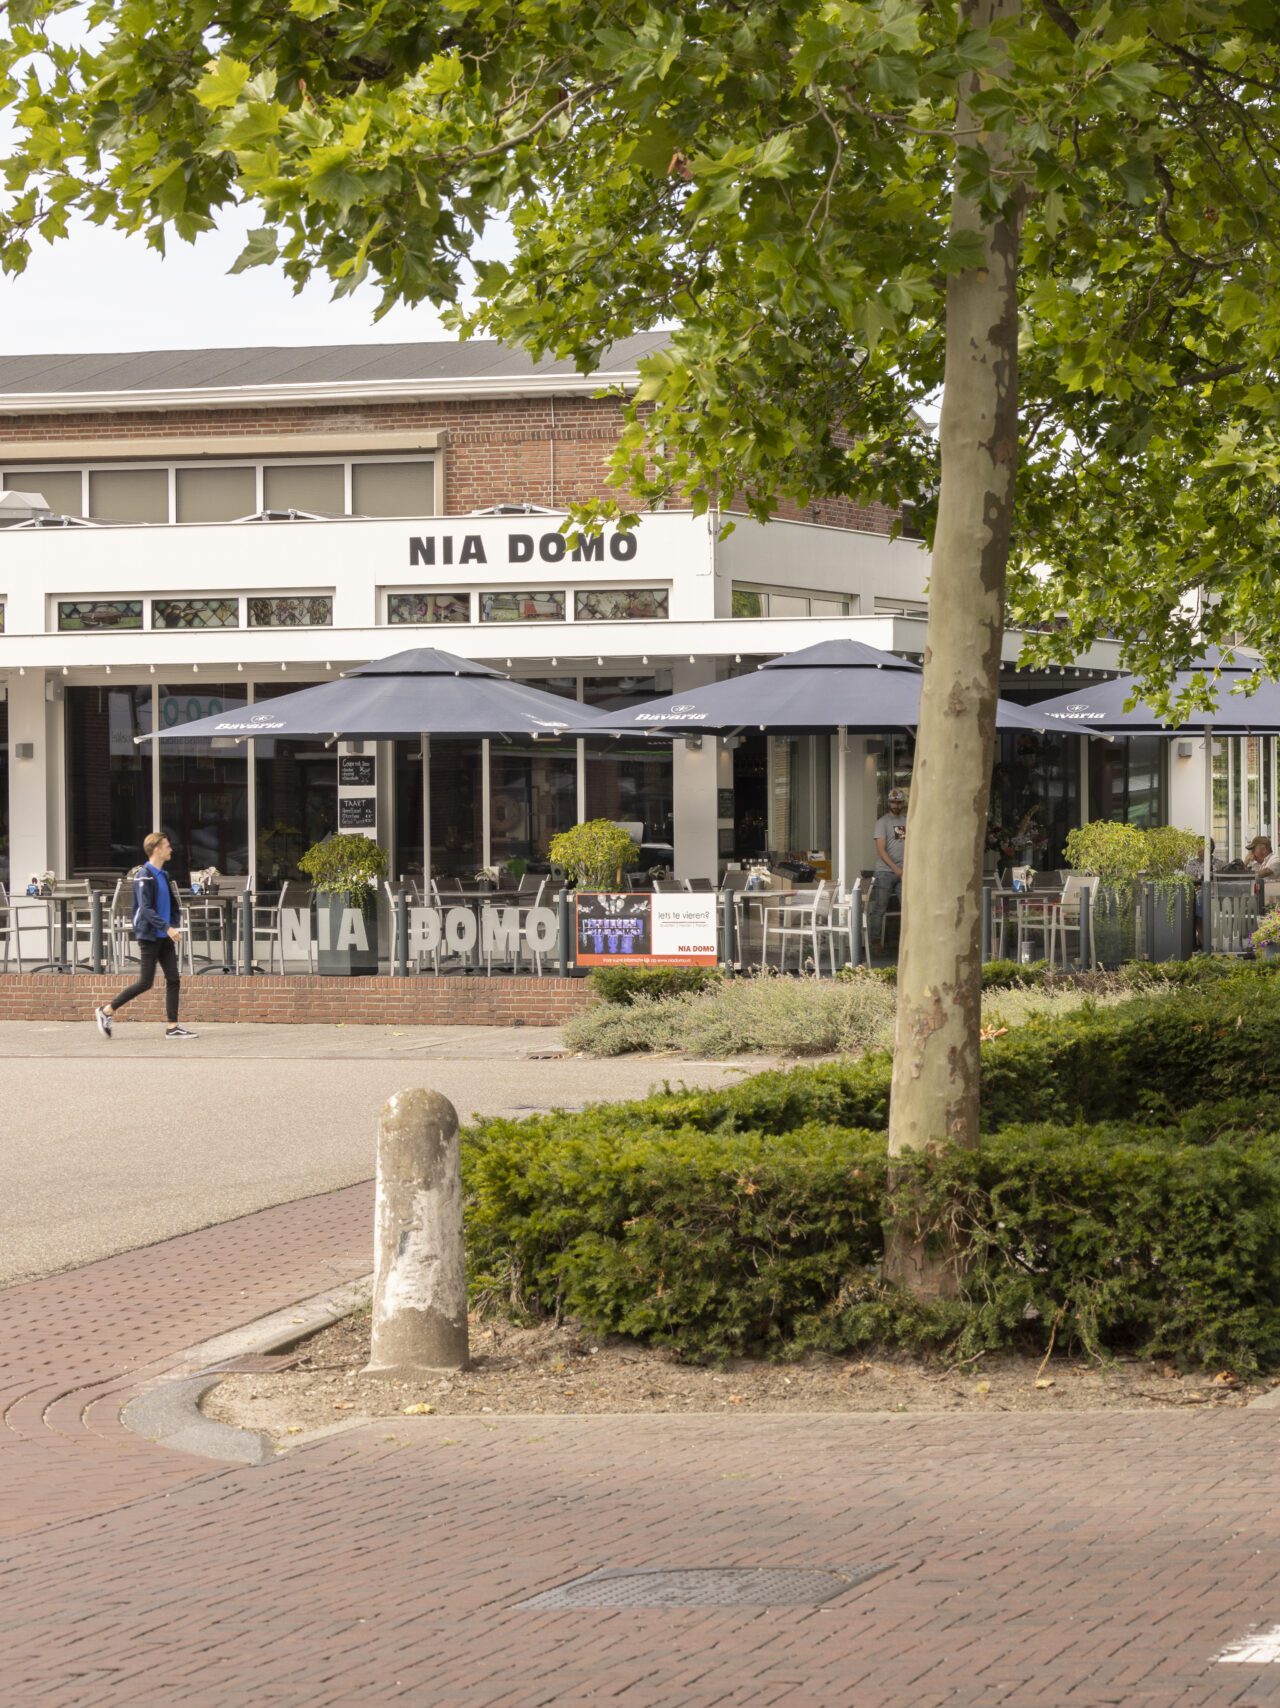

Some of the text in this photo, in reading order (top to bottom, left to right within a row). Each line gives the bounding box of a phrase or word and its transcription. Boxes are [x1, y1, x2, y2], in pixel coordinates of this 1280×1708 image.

[409, 532, 637, 565] NIA DOMO
[281, 906, 557, 952] NIA DOMO
[673, 912, 681, 920] te
